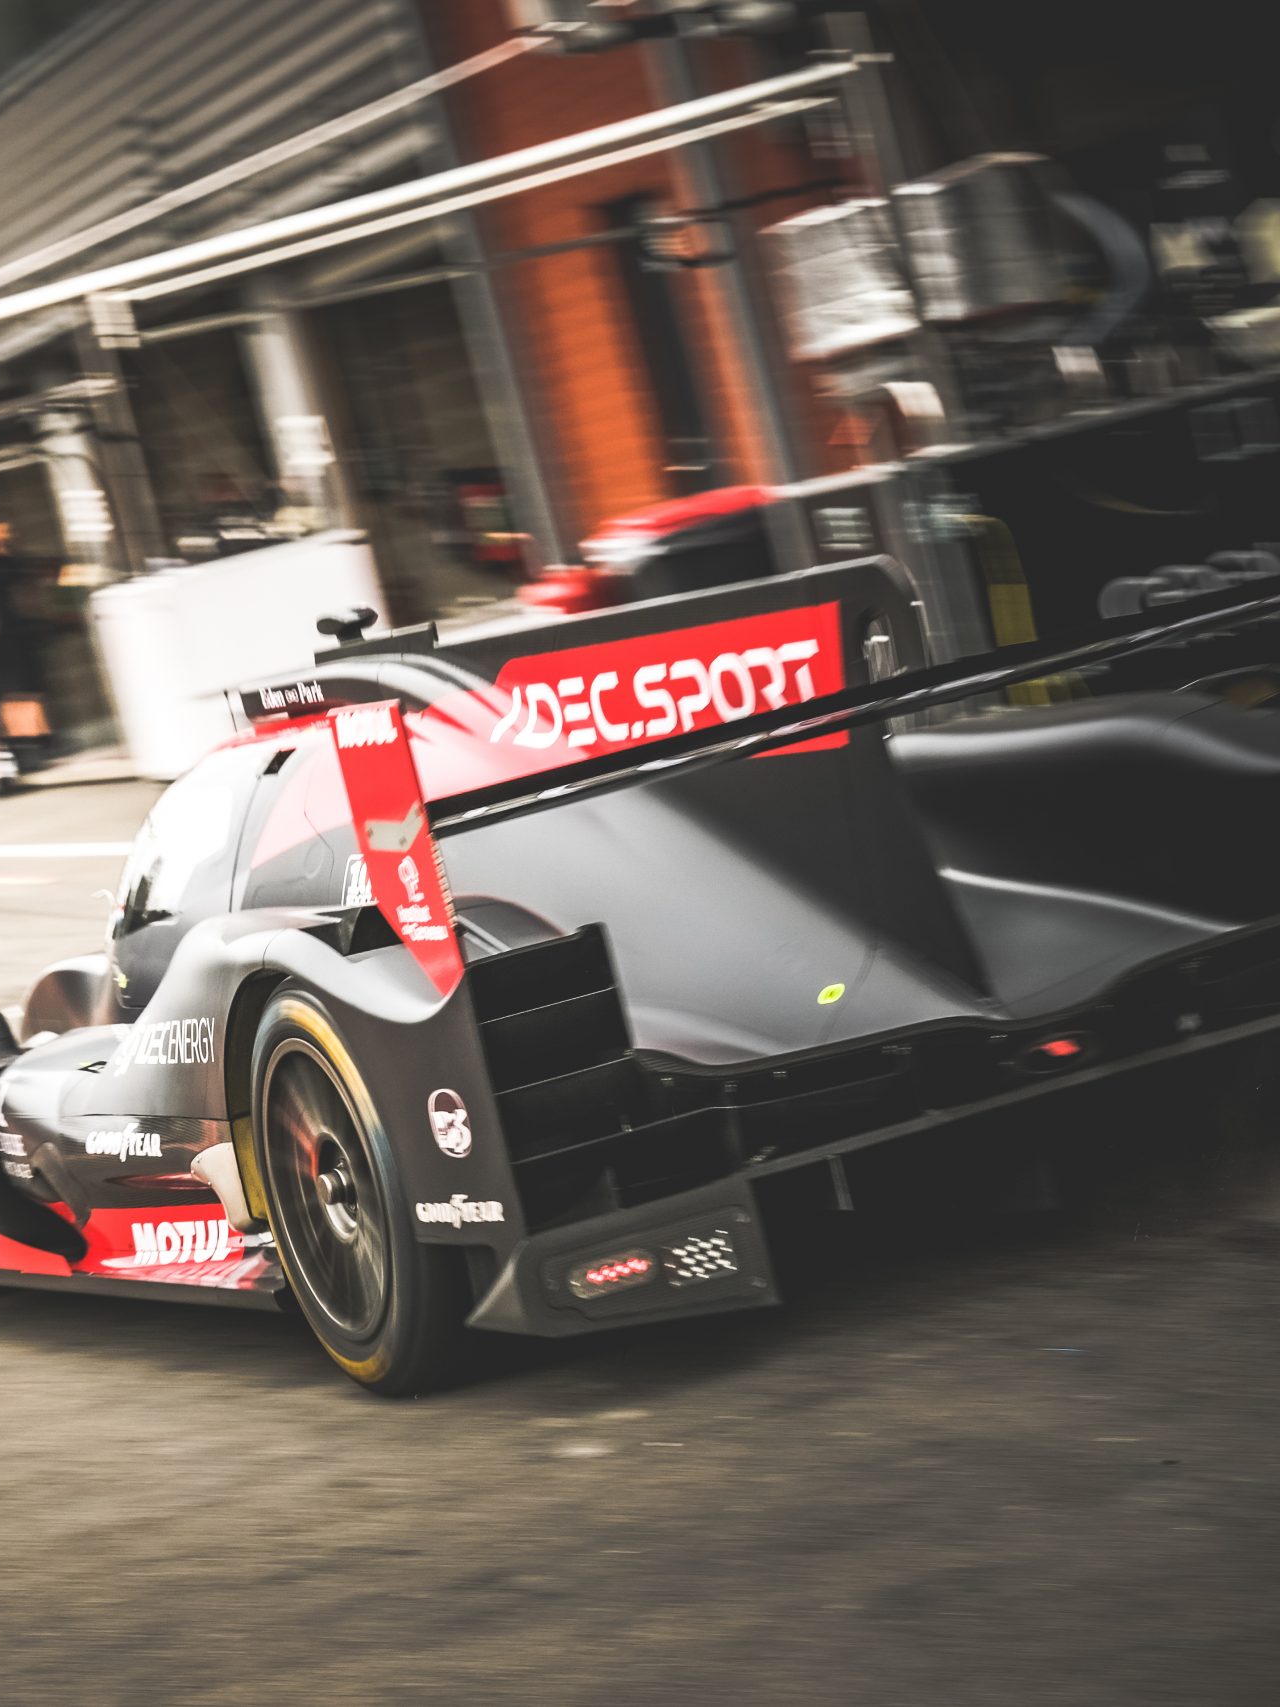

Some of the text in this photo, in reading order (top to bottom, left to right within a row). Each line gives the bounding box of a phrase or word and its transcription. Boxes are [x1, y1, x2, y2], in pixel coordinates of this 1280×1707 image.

[296, 679, 325, 705] Park
[85, 1122, 163, 1163] GOODYEAR
[131, 1219, 232, 1265] MOTUL
